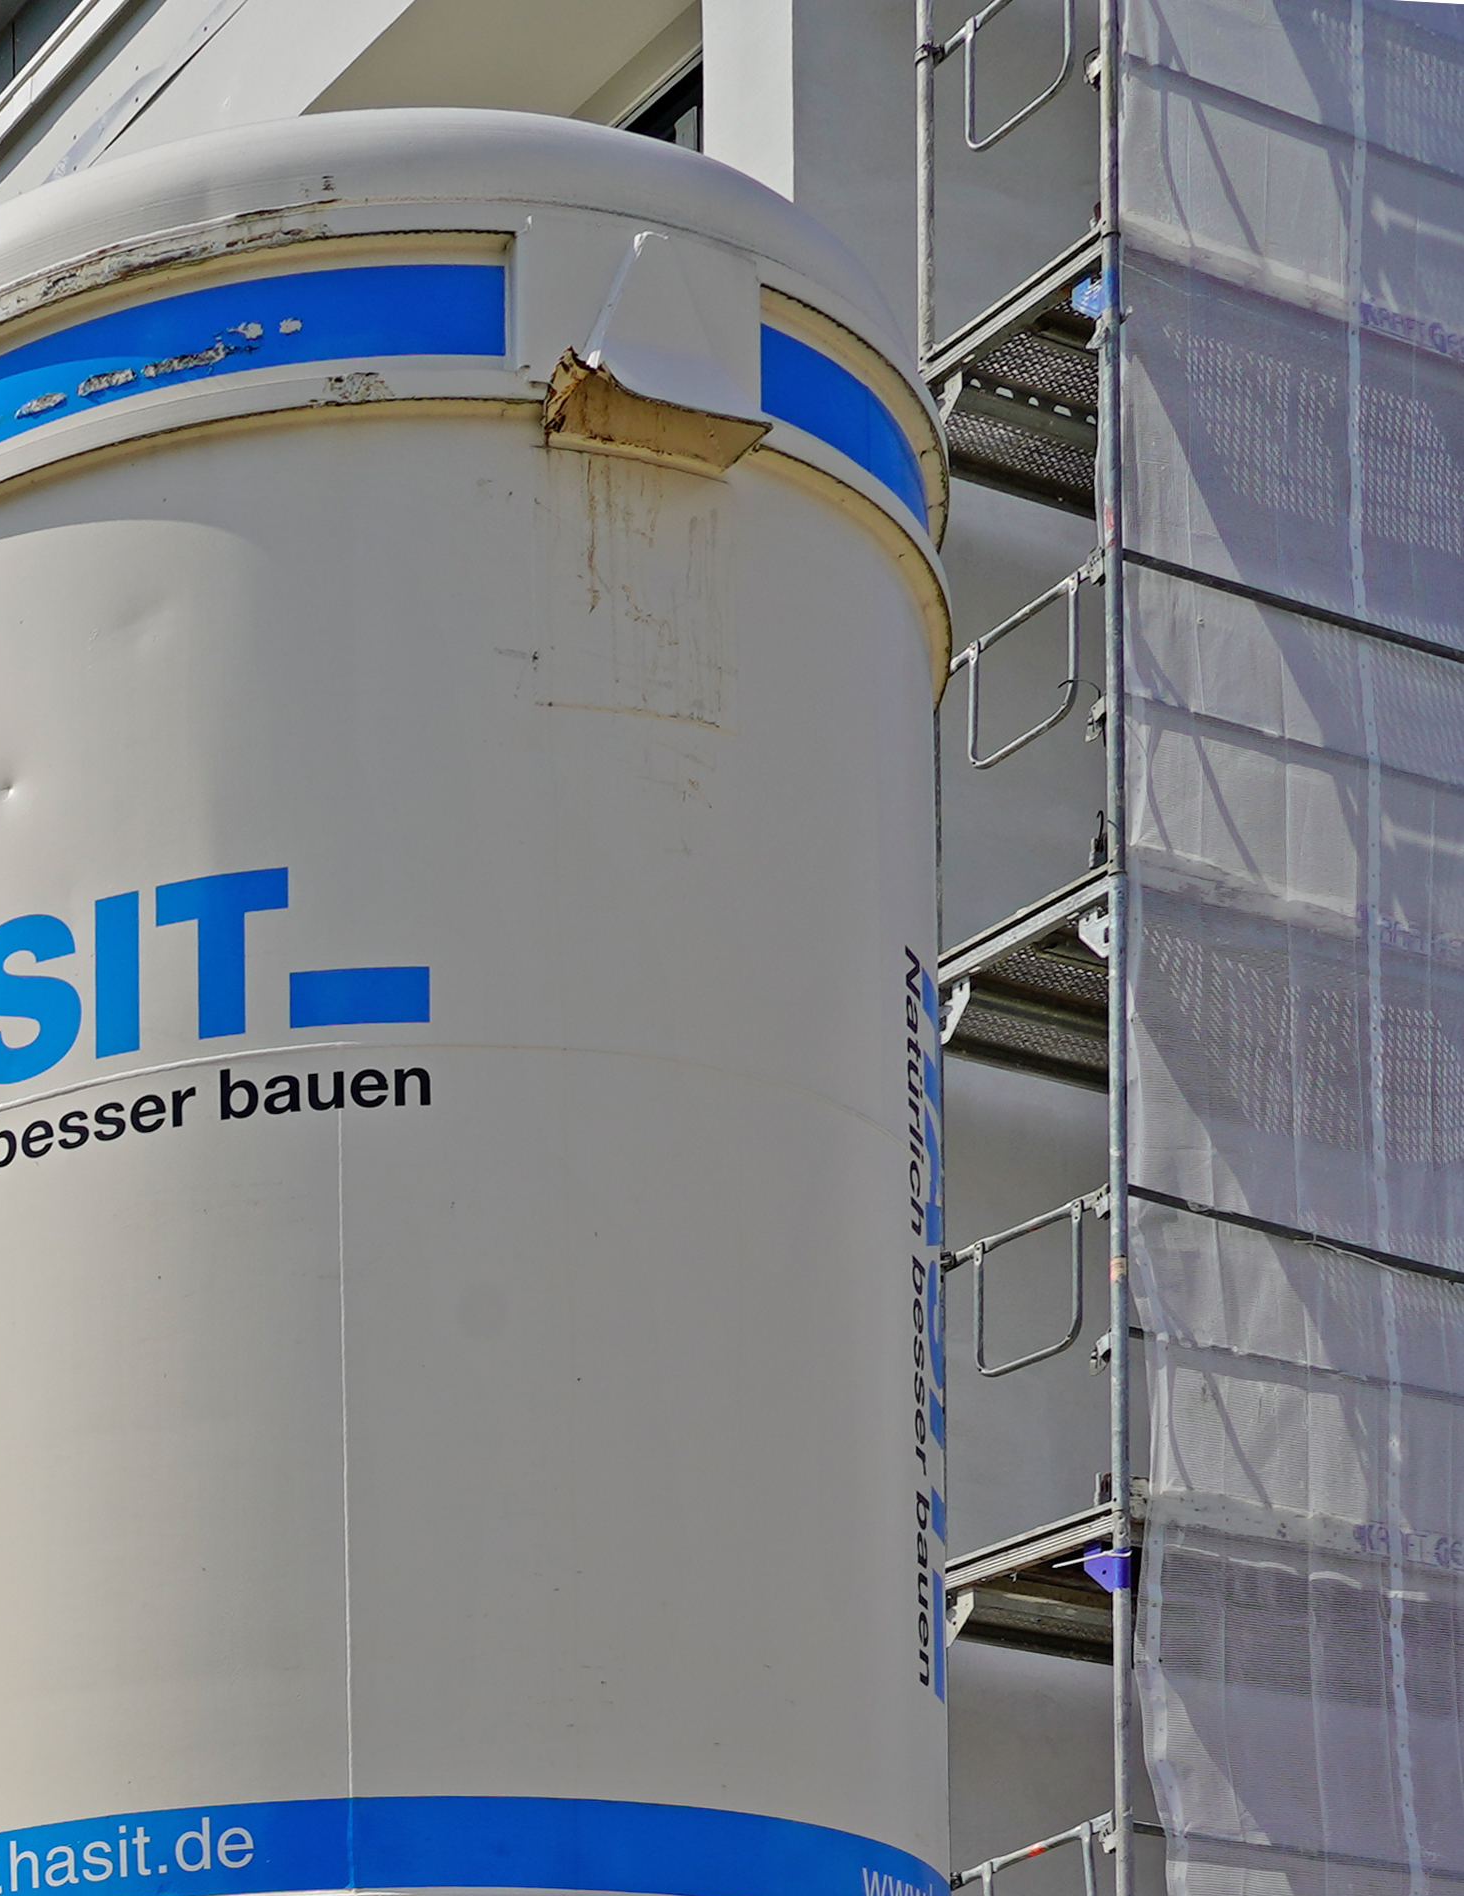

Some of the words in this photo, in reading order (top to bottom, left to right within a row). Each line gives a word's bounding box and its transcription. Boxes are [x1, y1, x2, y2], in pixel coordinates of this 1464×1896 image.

[220, 1066, 432, 1120] bauen
[904, 945, 925, 1237] Natürlich
[911, 1255, 927, 1476] besser
[916, 1490, 930, 1688] bauen
